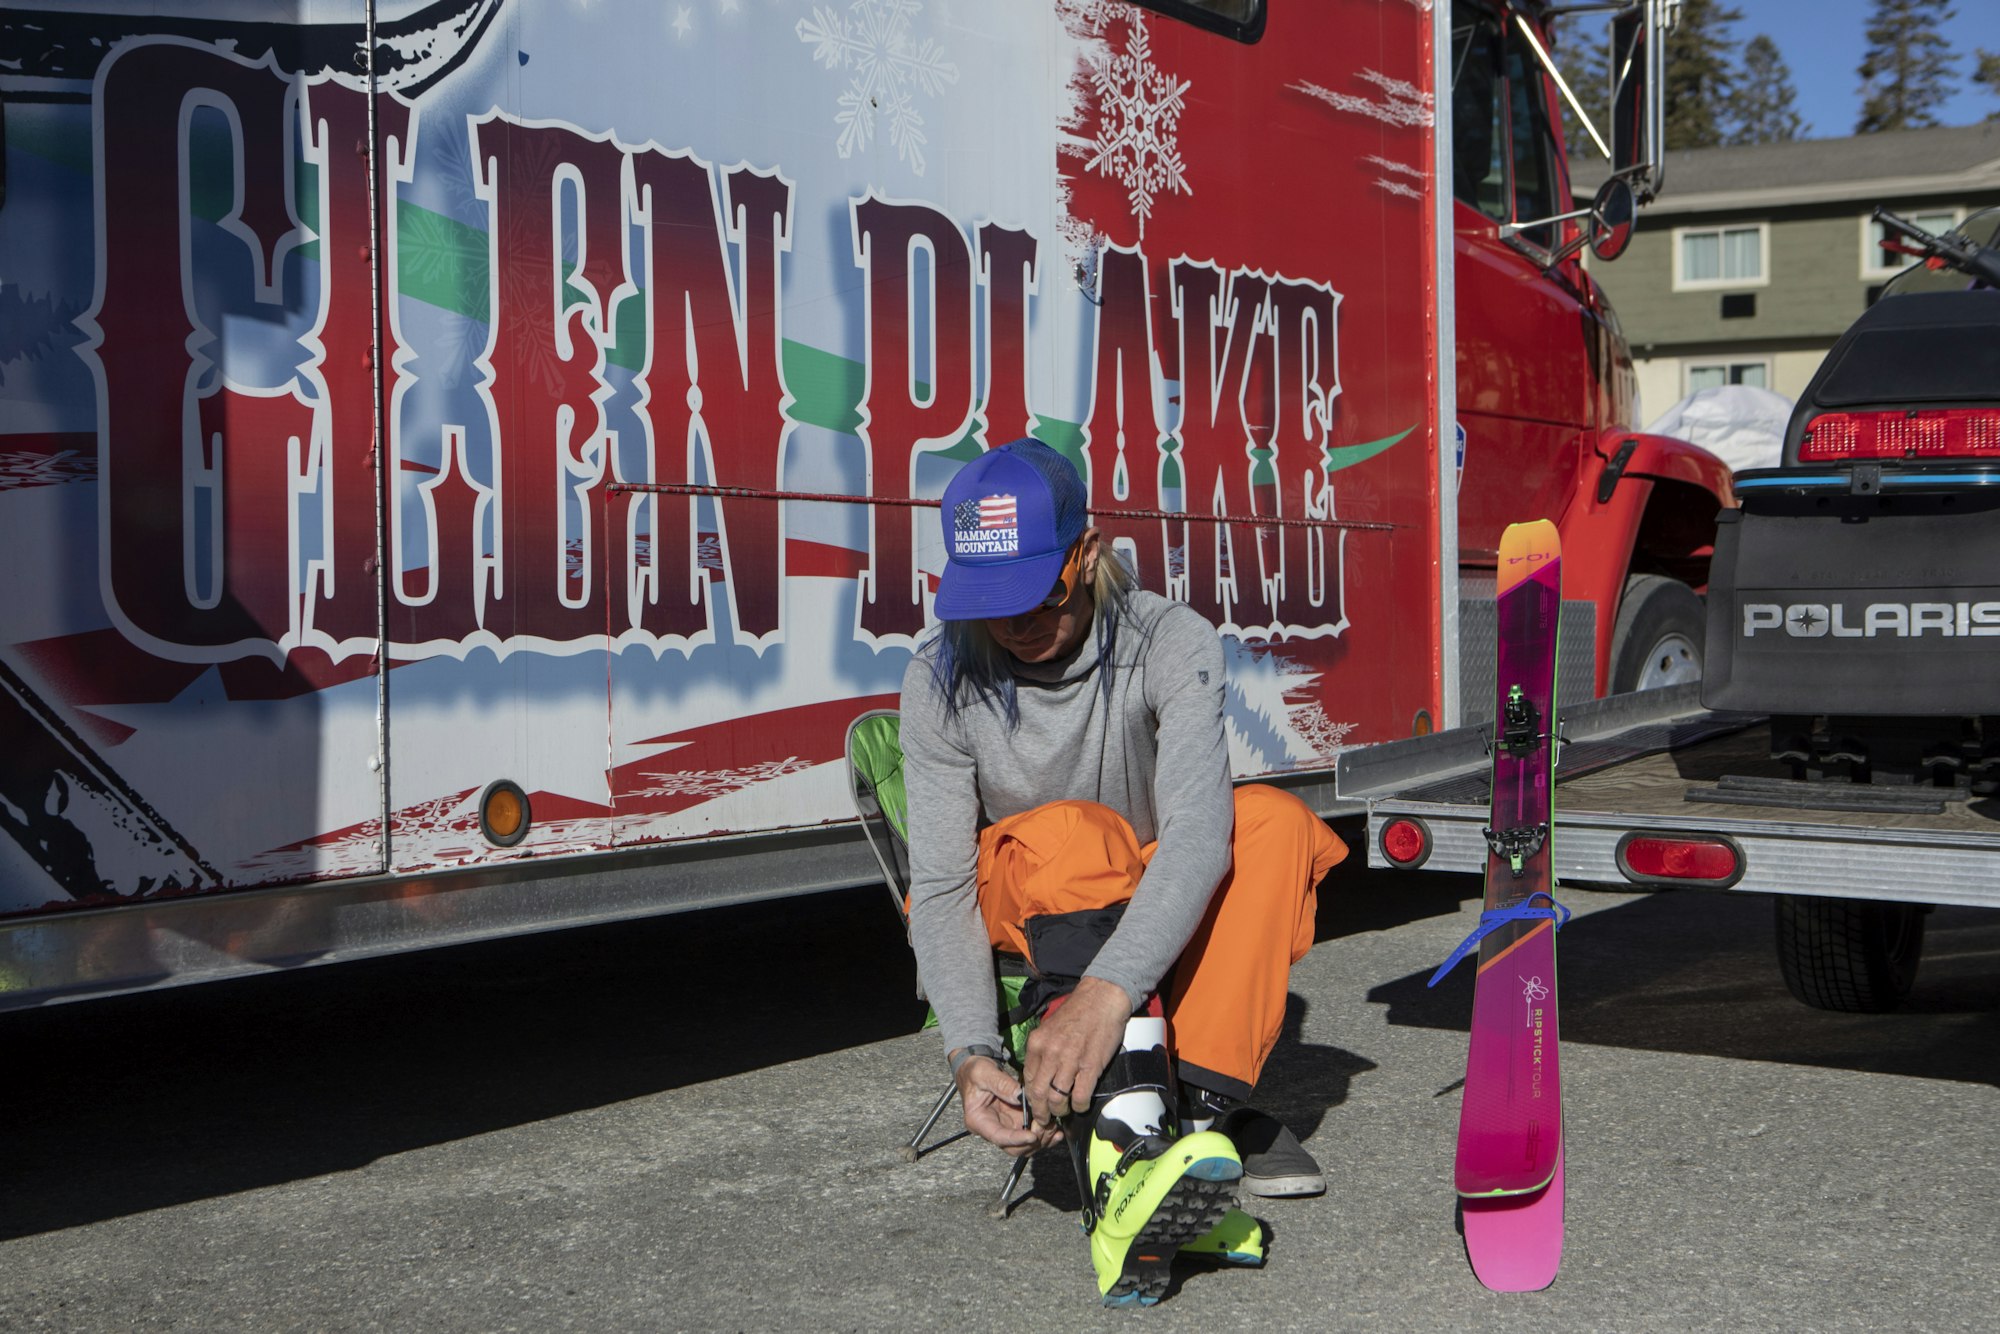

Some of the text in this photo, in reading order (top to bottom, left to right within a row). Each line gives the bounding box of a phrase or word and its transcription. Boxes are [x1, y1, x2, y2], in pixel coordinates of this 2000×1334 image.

[72, 33, 796, 669] GLEN
[954, 528, 1019, 542] MAMMOTH
[954, 540, 1019, 554] MOUNTAIN
[1506, 552, 1550, 565] 104
[1743, 602, 2000, 638] POLARIS
